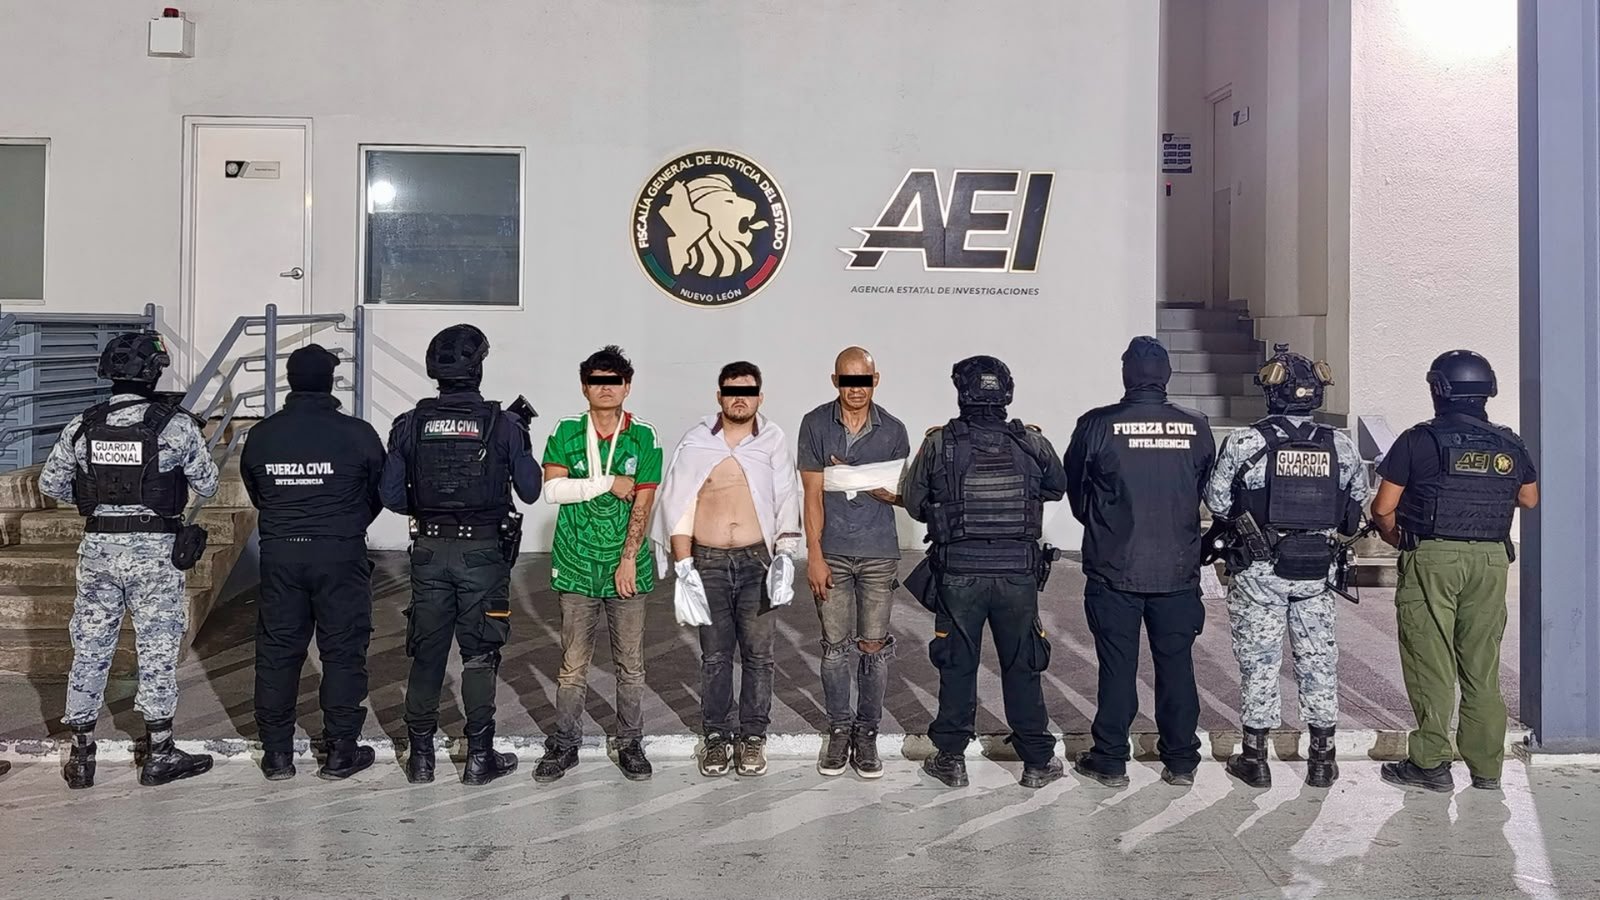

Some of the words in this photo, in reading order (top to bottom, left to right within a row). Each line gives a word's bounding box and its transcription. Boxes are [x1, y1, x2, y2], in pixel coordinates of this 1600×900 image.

[637, 197, 653, 249] FISCALÍA
[648, 157, 695, 199] GENERAL
[695, 154, 712, 166] DE
[713, 155, 760, 185] JUSTICIA
[758, 180, 775, 203] DEL
[770, 200, 785, 250] ESTADO
[836, 168, 1056, 274] AEI
[679, 287, 714, 302] NUEVO
[716, 288, 742, 301] LEÓN
[850, 285, 895, 294] AGENCIA
[896, 286, 936, 295] ESTATAL
[937, 286, 951, 295] DE
[952, 286, 1040, 296] INVESTIGACIONES
[424, 419, 456, 433] FUERZA
[457, 420, 479, 433] CIVIL
[1112, 422, 1164, 435] FUERZA
[1165, 422, 1197, 436] CIVIL
[94, 441, 137, 452] GUARDIA
[1128, 438, 1191, 450] INTELIGENCIA
[92, 451, 140, 463] NACIONAL
[1278, 452, 1328, 465] GUARDIA
[1455, 452, 1490, 473] AEI
[265, 463, 305, 475] FUERZA
[306, 462, 334, 475] CIVIL
[1278, 464, 1329, 477] NACIONAL
